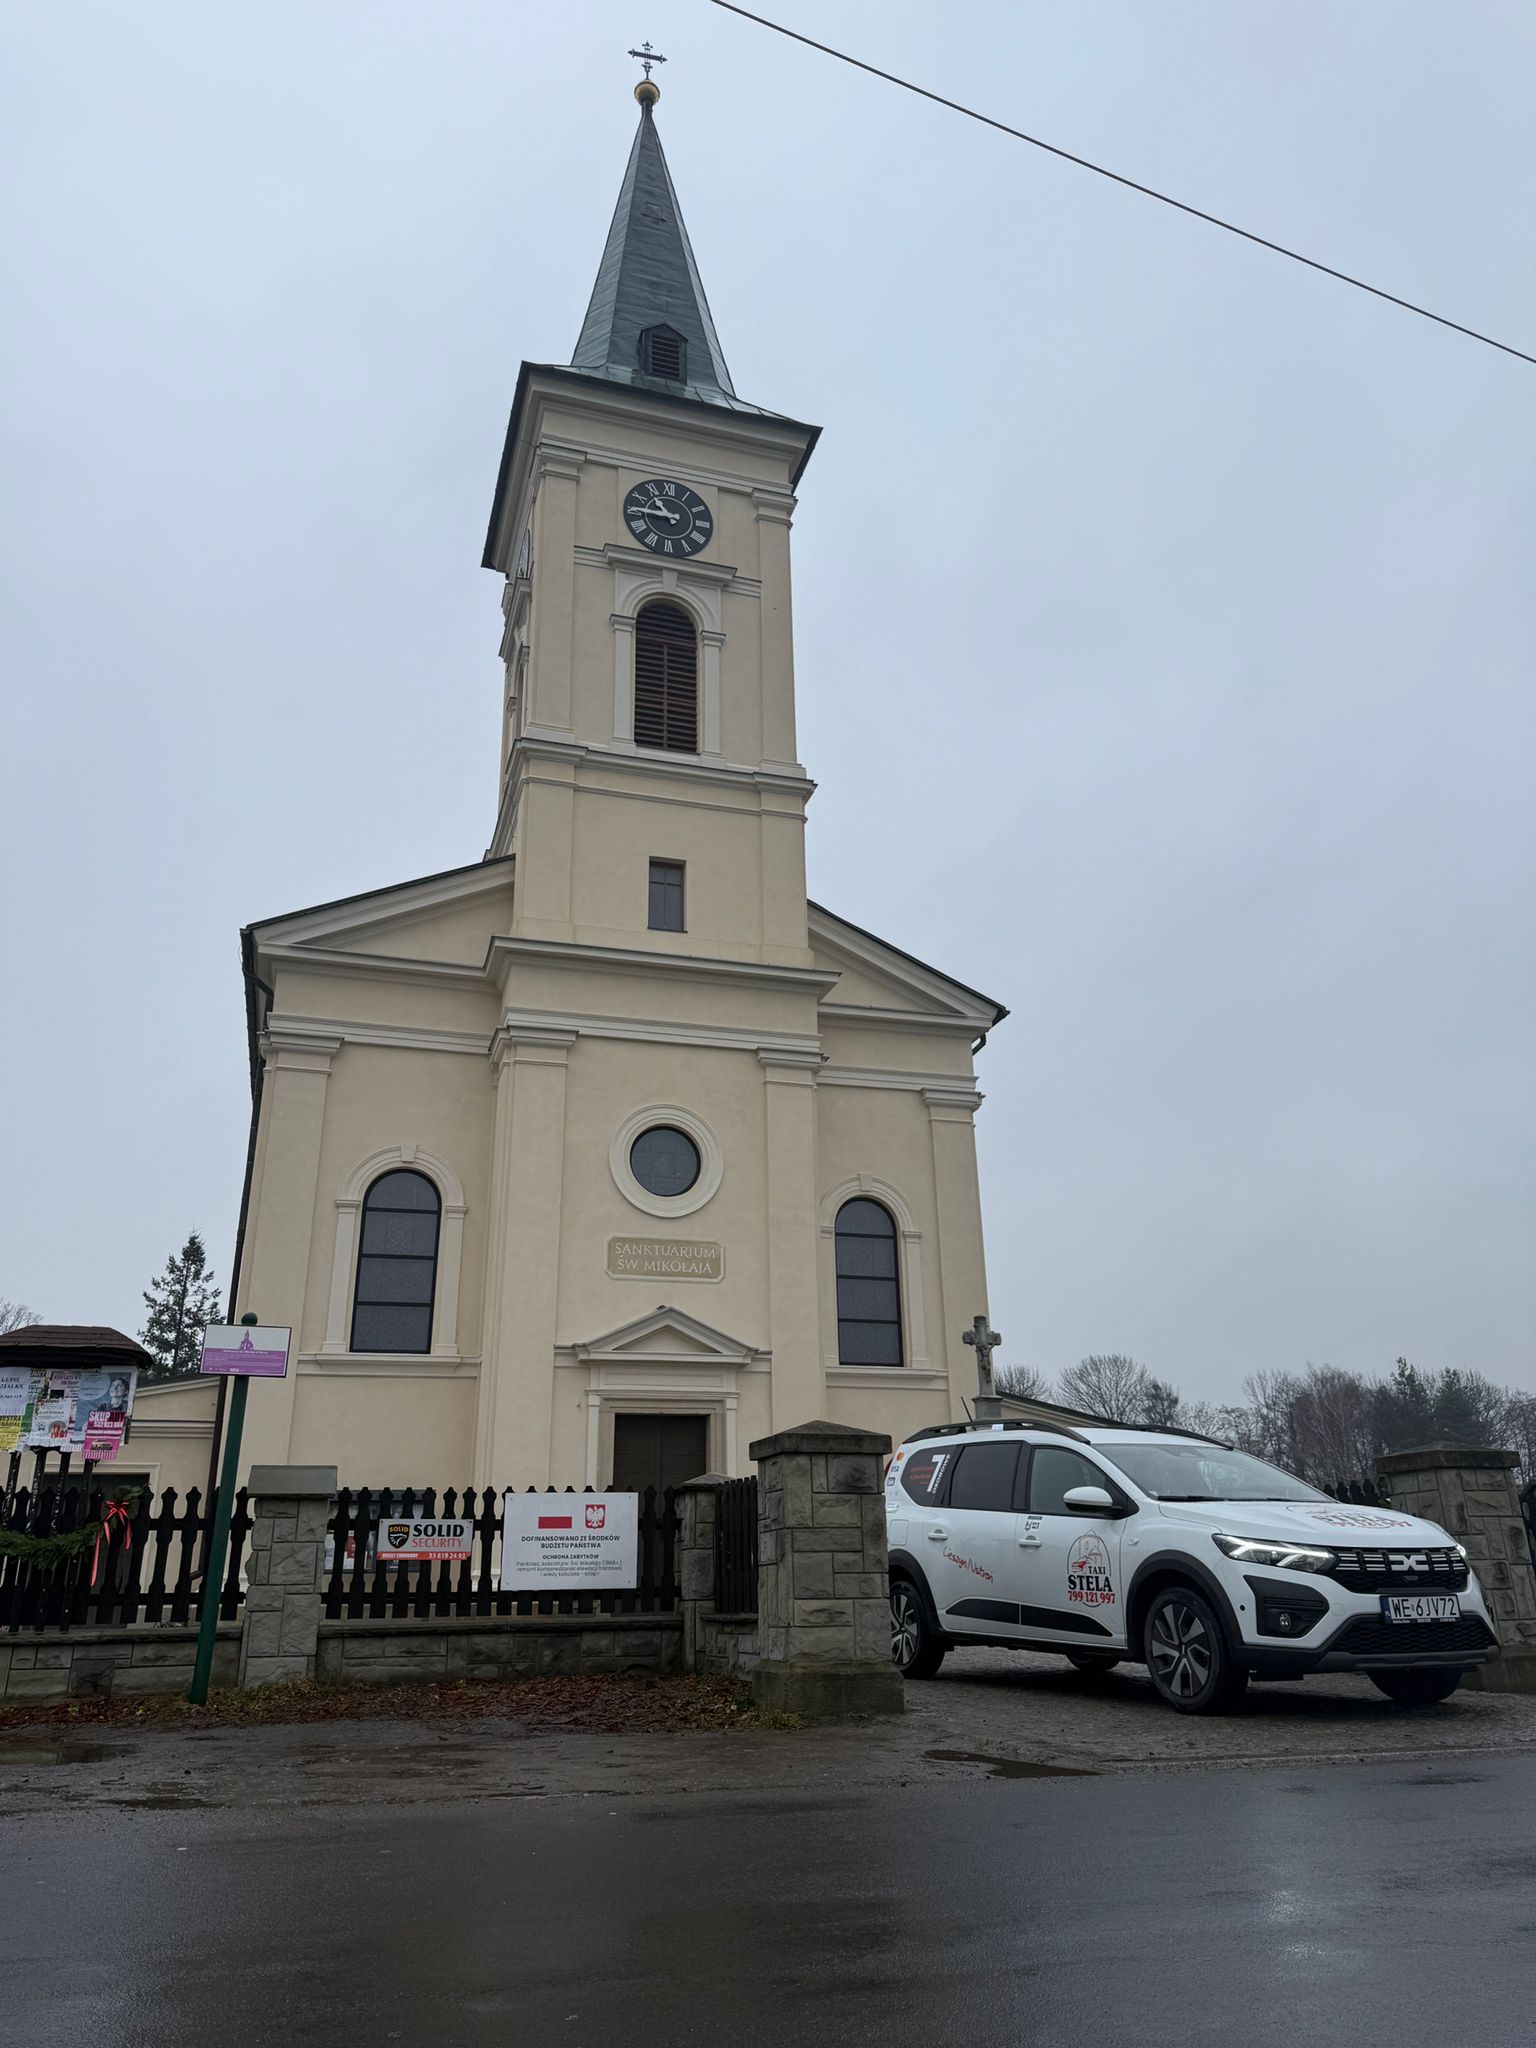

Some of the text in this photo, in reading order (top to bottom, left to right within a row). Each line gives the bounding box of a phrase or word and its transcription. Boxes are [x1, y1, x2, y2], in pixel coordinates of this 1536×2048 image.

[663, 482, 675, 496] XII
[615, 1242, 716, 1259] SANKTUARIUM
[617, 1254, 713, 1274] ŚW. MIKOŁAJA
[89, 1411, 110, 1422] SKUP
[927, 1454, 946, 1493] 7
[412, 1523, 465, 1538] SOLID
[411, 1537, 464, 1548] SECURITY
[1088, 1566, 1106, 1575] TAXI
[1068, 1574, 1113, 1593] STELA
[1068, 1590, 1116, 1605] 799 121 997
[1391, 1597, 1457, 1618] WE 6JV72
